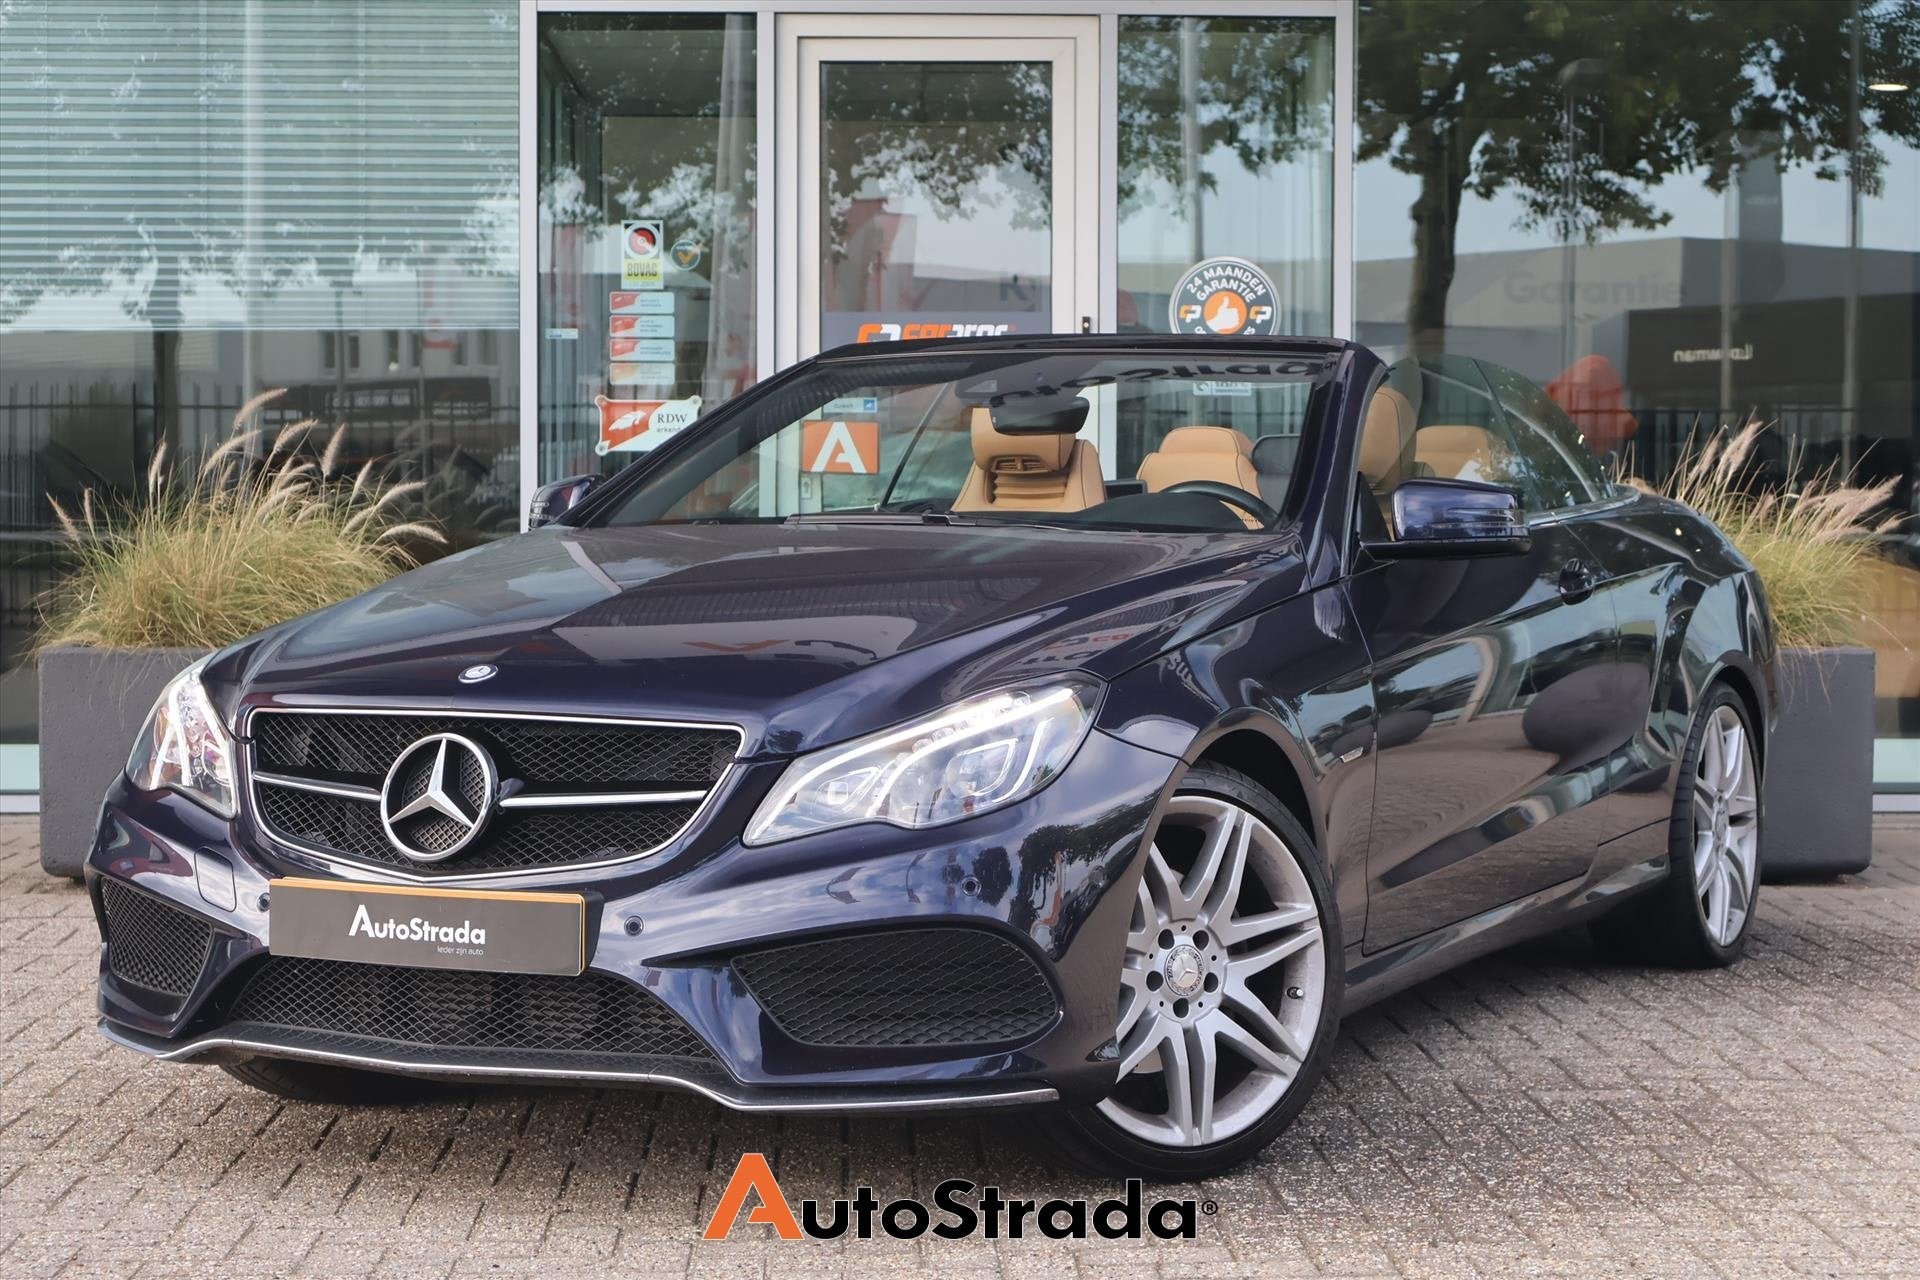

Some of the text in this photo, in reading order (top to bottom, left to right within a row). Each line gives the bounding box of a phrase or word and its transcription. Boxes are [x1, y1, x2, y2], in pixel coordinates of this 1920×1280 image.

[627, 262, 658, 277] BOVAG
[1186, 265, 1267, 296] 24 MAANDEN
[1196, 278, 1256, 303] GARANTIE
[1504, 269, 1684, 304] Garantie
[657, 413, 688, 424] RDW
[810, 421, 867, 473] A
[348, 904, 486, 945] AutoStrada
